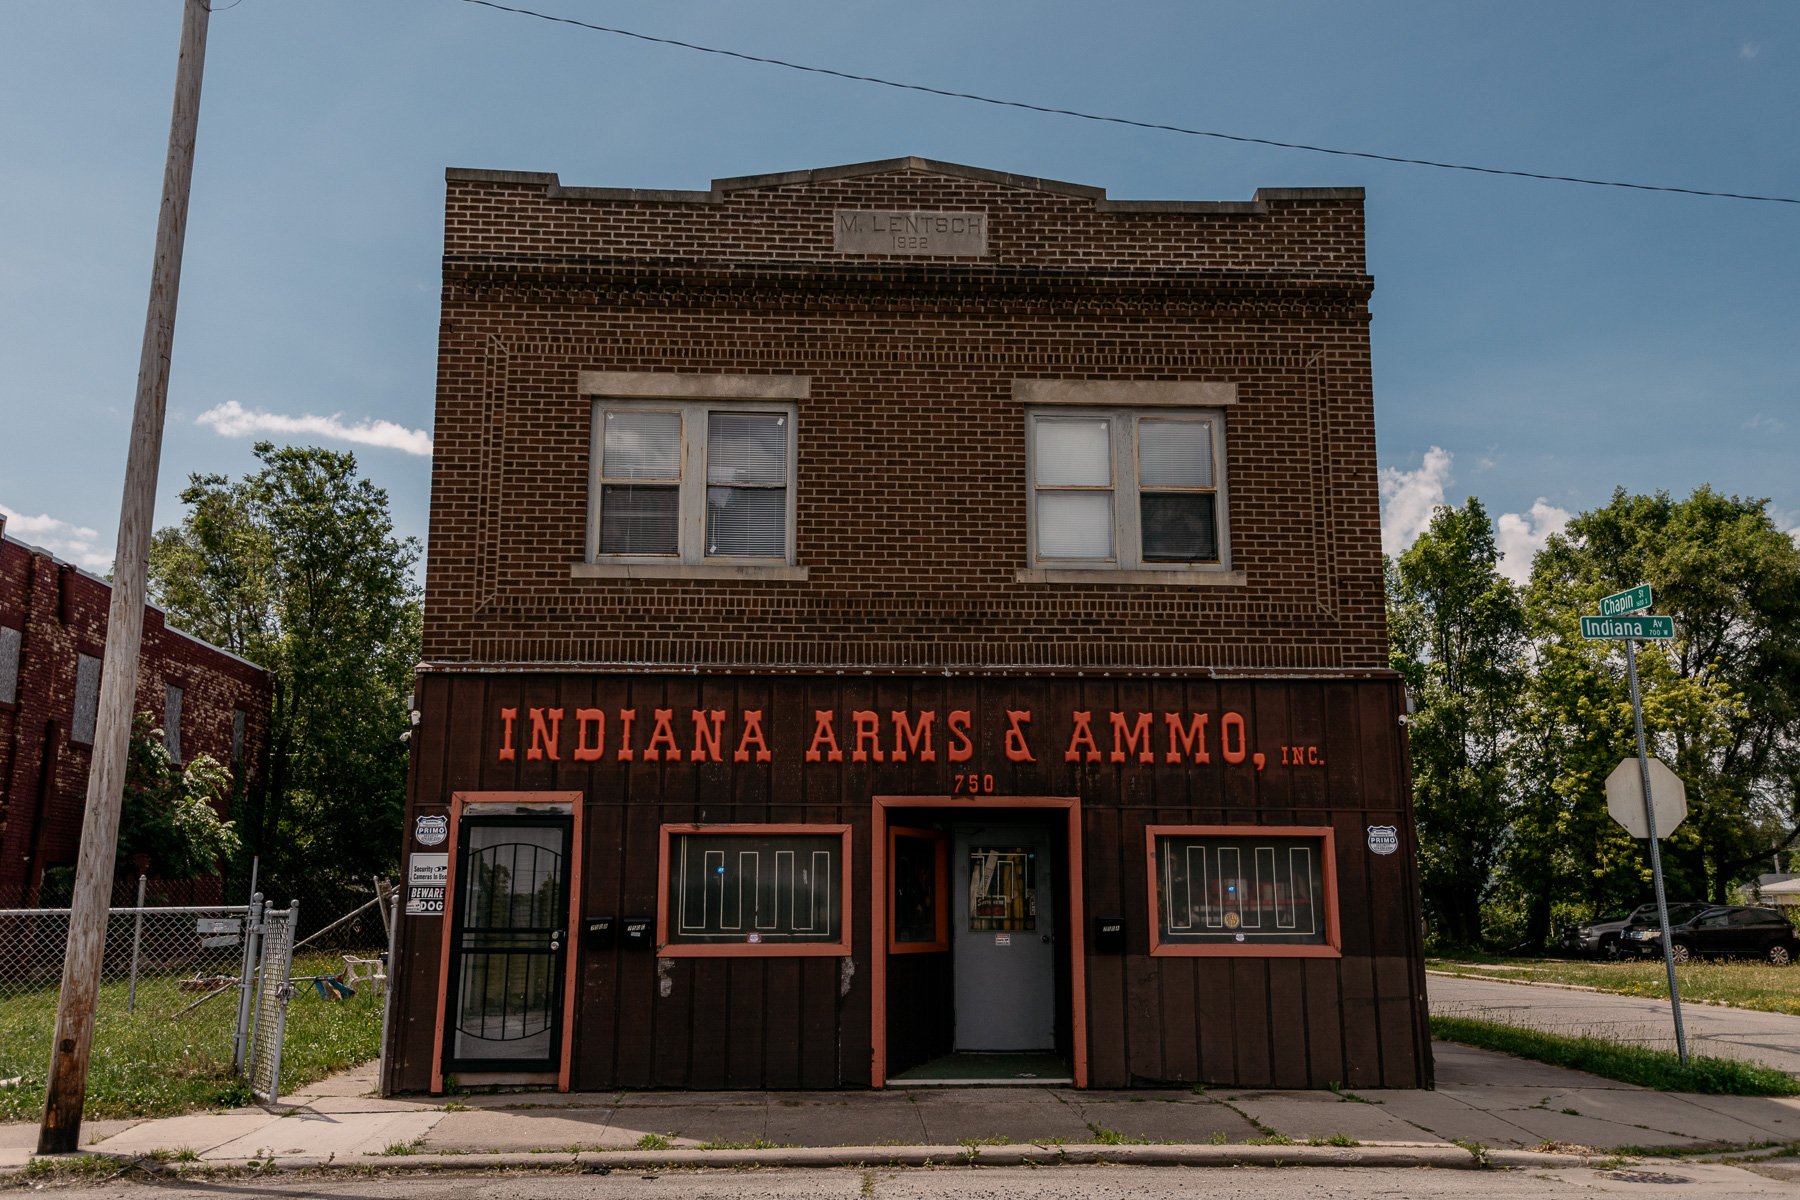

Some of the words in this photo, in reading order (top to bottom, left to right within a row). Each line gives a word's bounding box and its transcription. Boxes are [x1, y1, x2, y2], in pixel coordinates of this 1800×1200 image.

[840, 215, 863, 233] M.
[873, 216, 981, 234] LENTSCH
[892, 236, 928, 249] 1922
[1604, 593, 1634, 615] Chapin
[1586, 619, 1643, 636] Indiana
[499, 707, 772, 763] INDIANA
[805, 709, 974, 763] ARMS
[1004, 709, 1037, 763] &
[1064, 711, 1266, 771] AMMO,
[1281, 746, 1325, 766] INC.
[954, 774, 994, 793] 750
[413, 865, 433, 874] Security
[413, 873, 433, 881] Cameras
[410, 887, 444, 898] BEWARE
[420, 900, 443, 911] DOG
